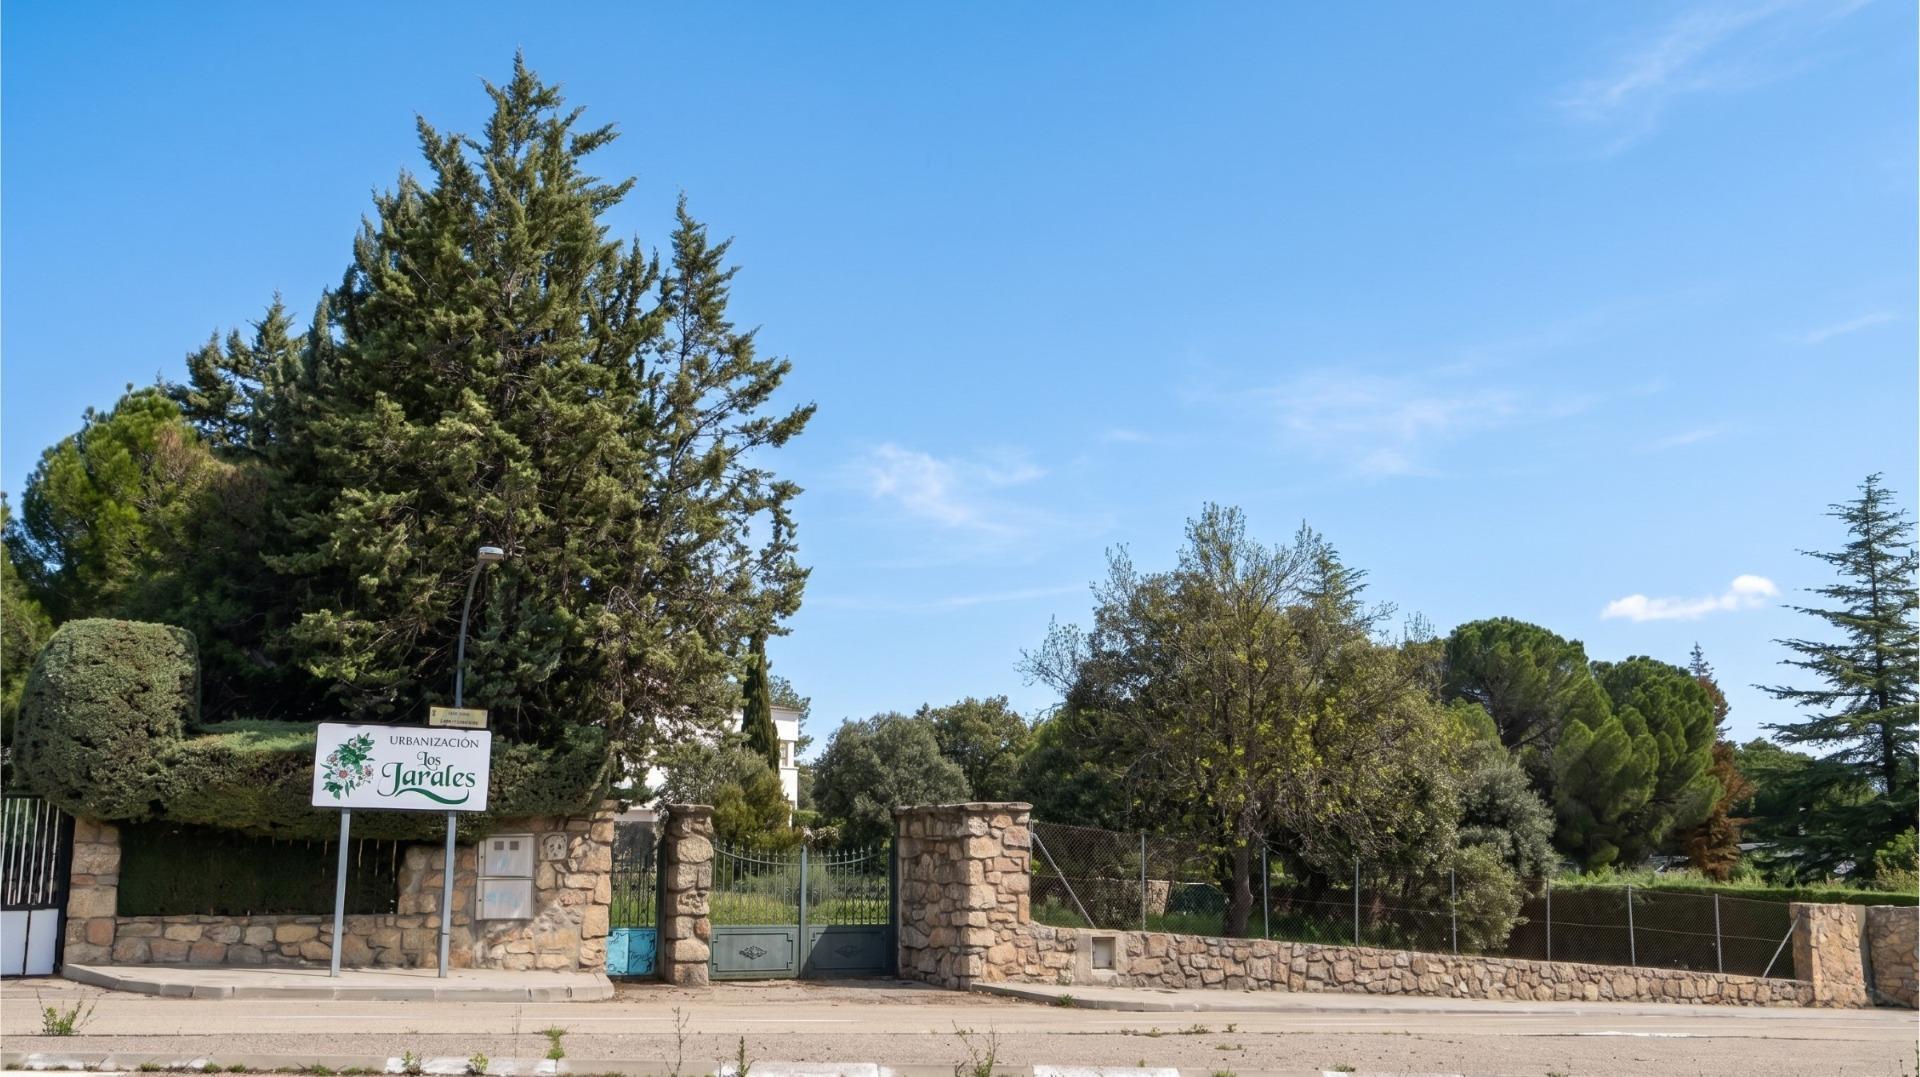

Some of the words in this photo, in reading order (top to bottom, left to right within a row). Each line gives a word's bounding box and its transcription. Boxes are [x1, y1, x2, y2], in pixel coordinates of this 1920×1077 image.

[390, 735, 479, 749] URBANIZACIÓN
[416, 751, 442, 771] Los
[377, 762, 476, 798] Jarales
